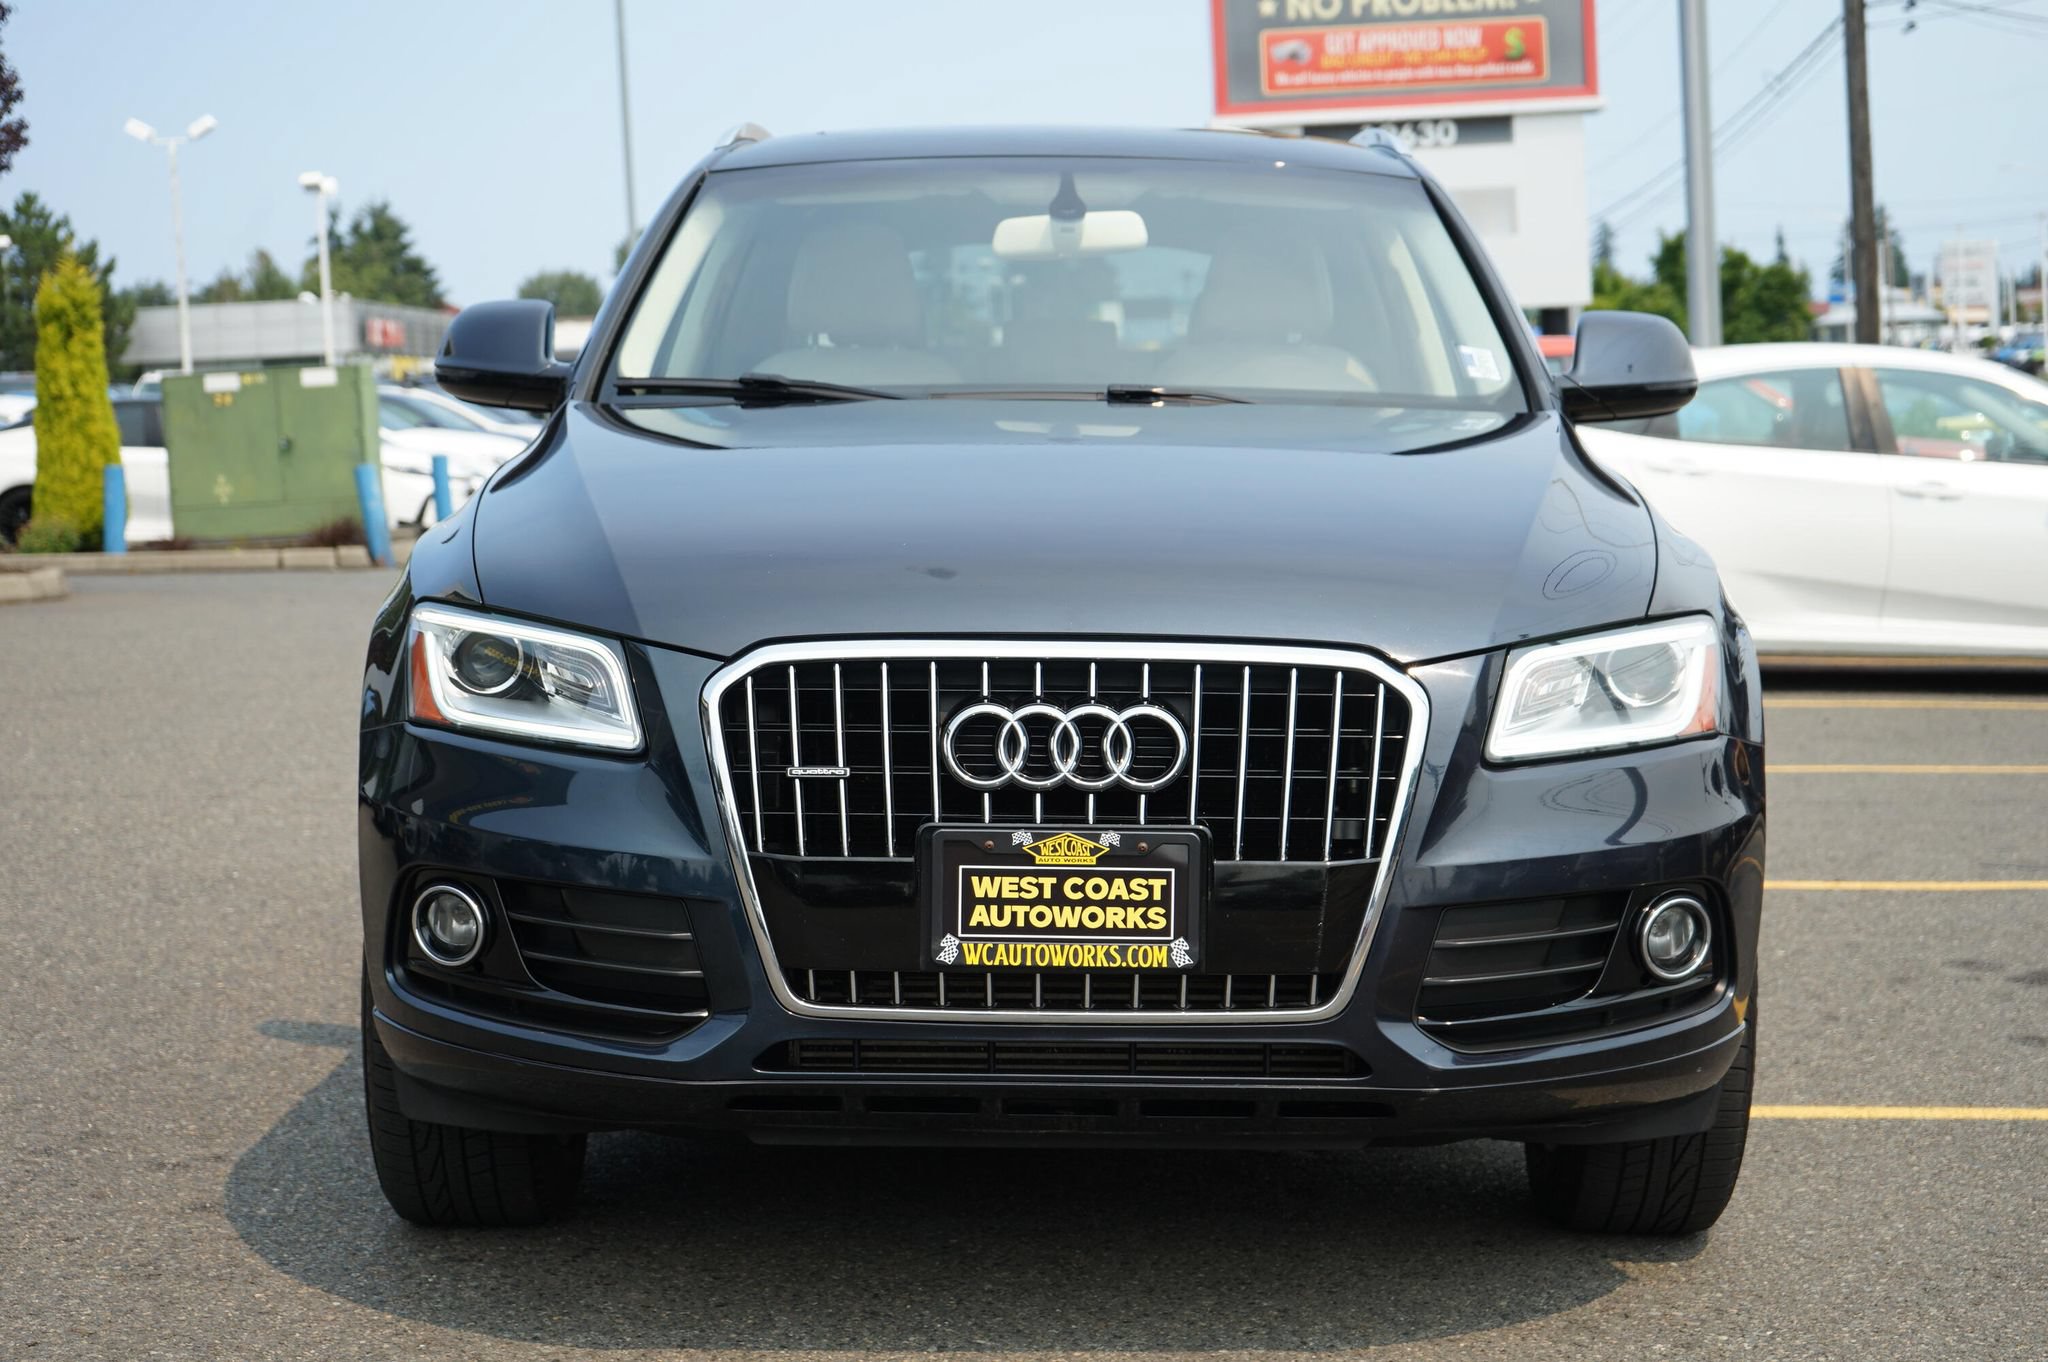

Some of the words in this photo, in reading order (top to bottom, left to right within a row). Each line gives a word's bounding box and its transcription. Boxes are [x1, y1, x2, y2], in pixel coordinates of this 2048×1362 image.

[1284, 0, 1343, 20] NO
[1324, 31, 1355, 55] GET
[1359, 28, 1440, 53] APPROVED
[1443, 26, 1482, 49] NOW
[1362, 118, 1459, 147] 630
[791, 768, 845, 776] quattro
[971, 876, 1057, 900] WEST
[1063, 877, 1167, 901] COAST
[968, 904, 1167, 930] AUTOWORKS
[962, 942, 1168, 968] WCAUTOWORKS.COM
